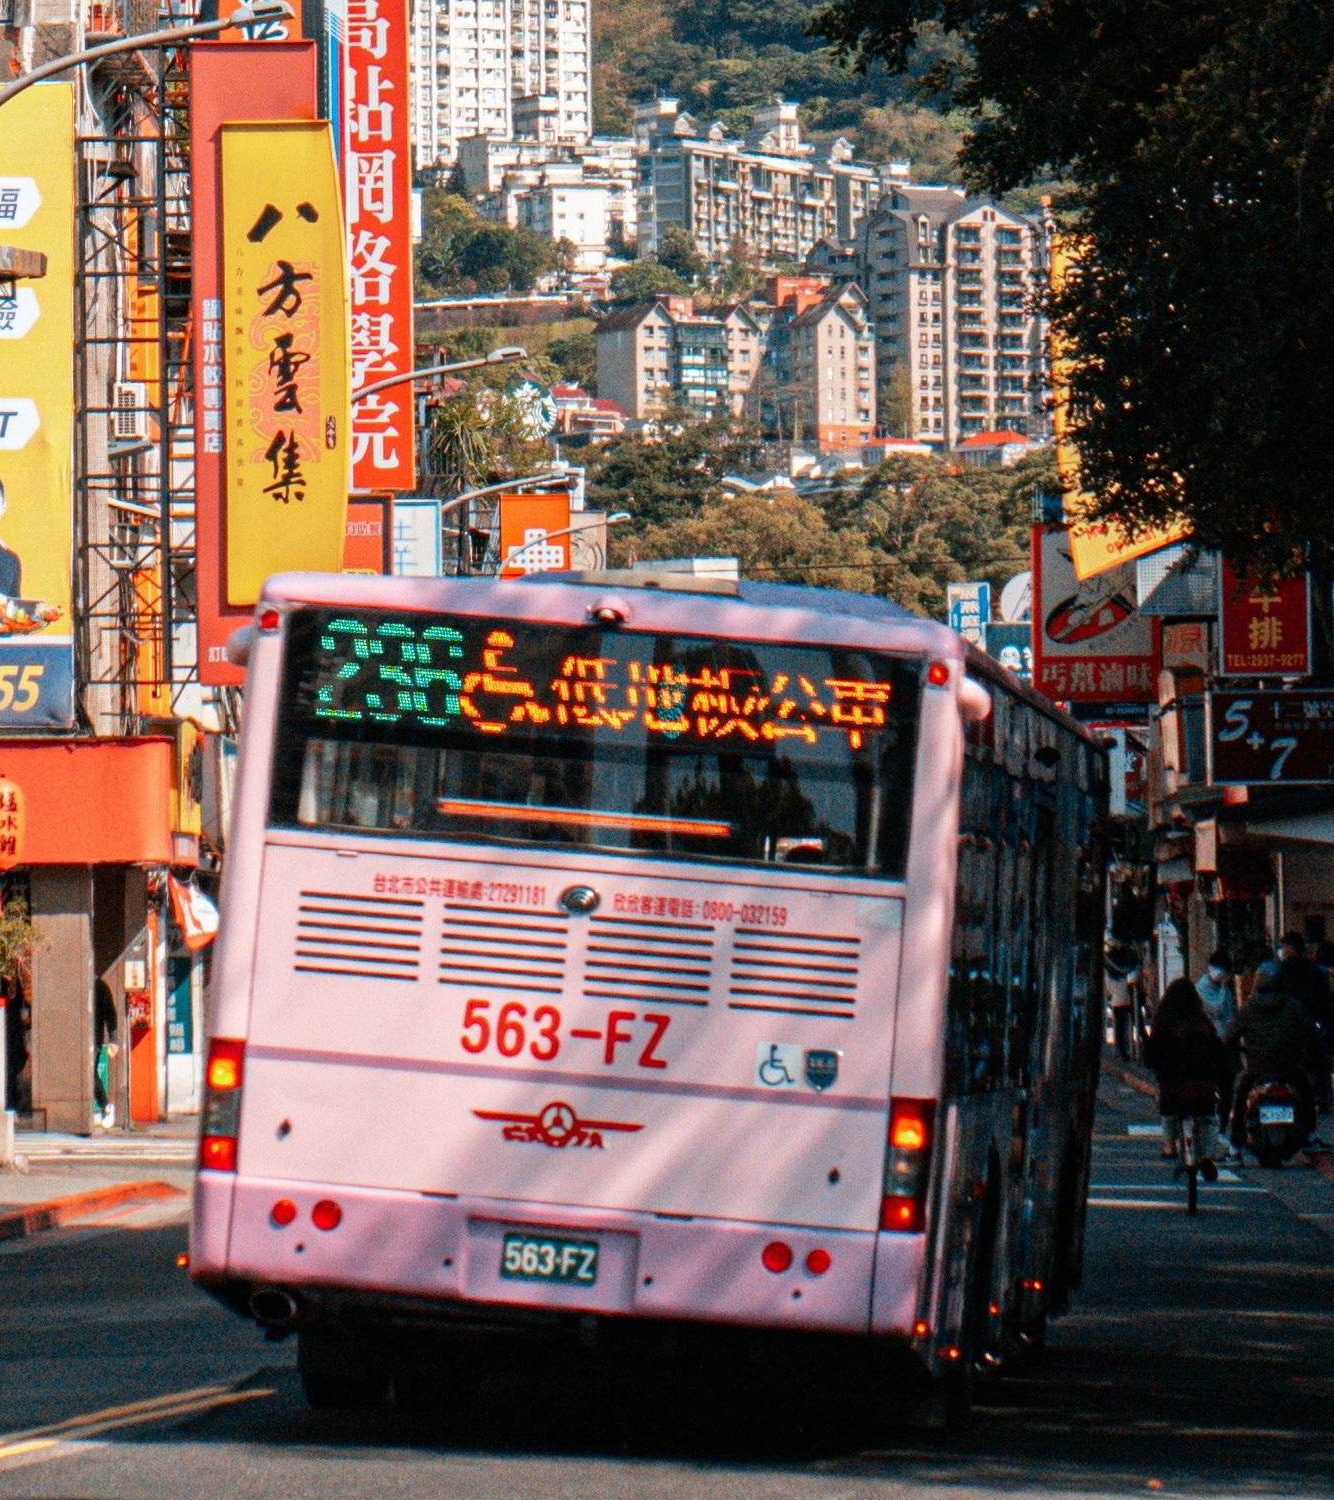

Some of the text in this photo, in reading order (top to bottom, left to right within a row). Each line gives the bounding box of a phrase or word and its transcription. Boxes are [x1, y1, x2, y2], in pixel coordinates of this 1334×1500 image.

[246, 202, 320, 504] 八方雲集
[461, 998, 671, 1069] 563-FZ
